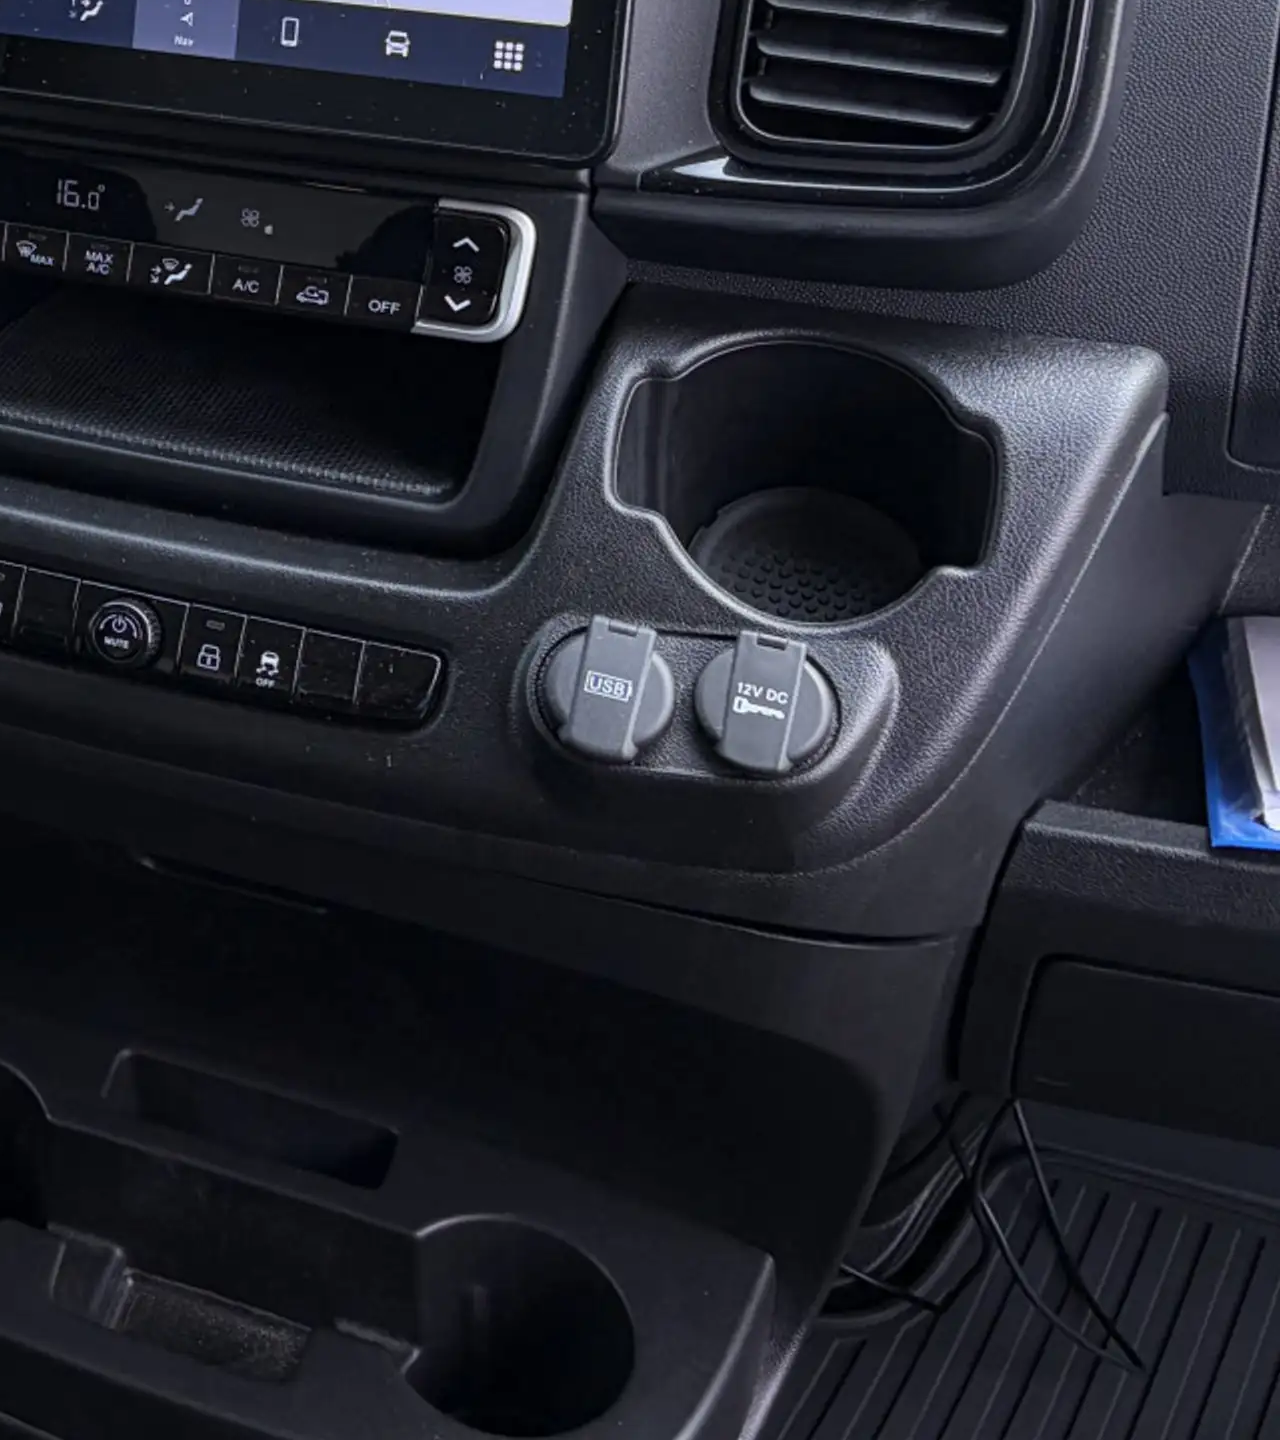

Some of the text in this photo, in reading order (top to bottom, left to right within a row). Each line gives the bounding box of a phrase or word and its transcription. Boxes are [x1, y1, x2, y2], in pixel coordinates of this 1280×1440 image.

[174, 35, 194, 47] Nav
[30, 253, 55, 267] MAX
[85, 249, 114, 265] MAX
[86, 262, 110, 276] A/C
[232, 277, 260, 294] A/C
[367, 298, 402, 316] OFF
[103, 635, 130, 651] MUTE
[255, 677, 276, 690] OFF
[589, 674, 627, 698] USB
[737, 681, 790, 705] 12V DC
